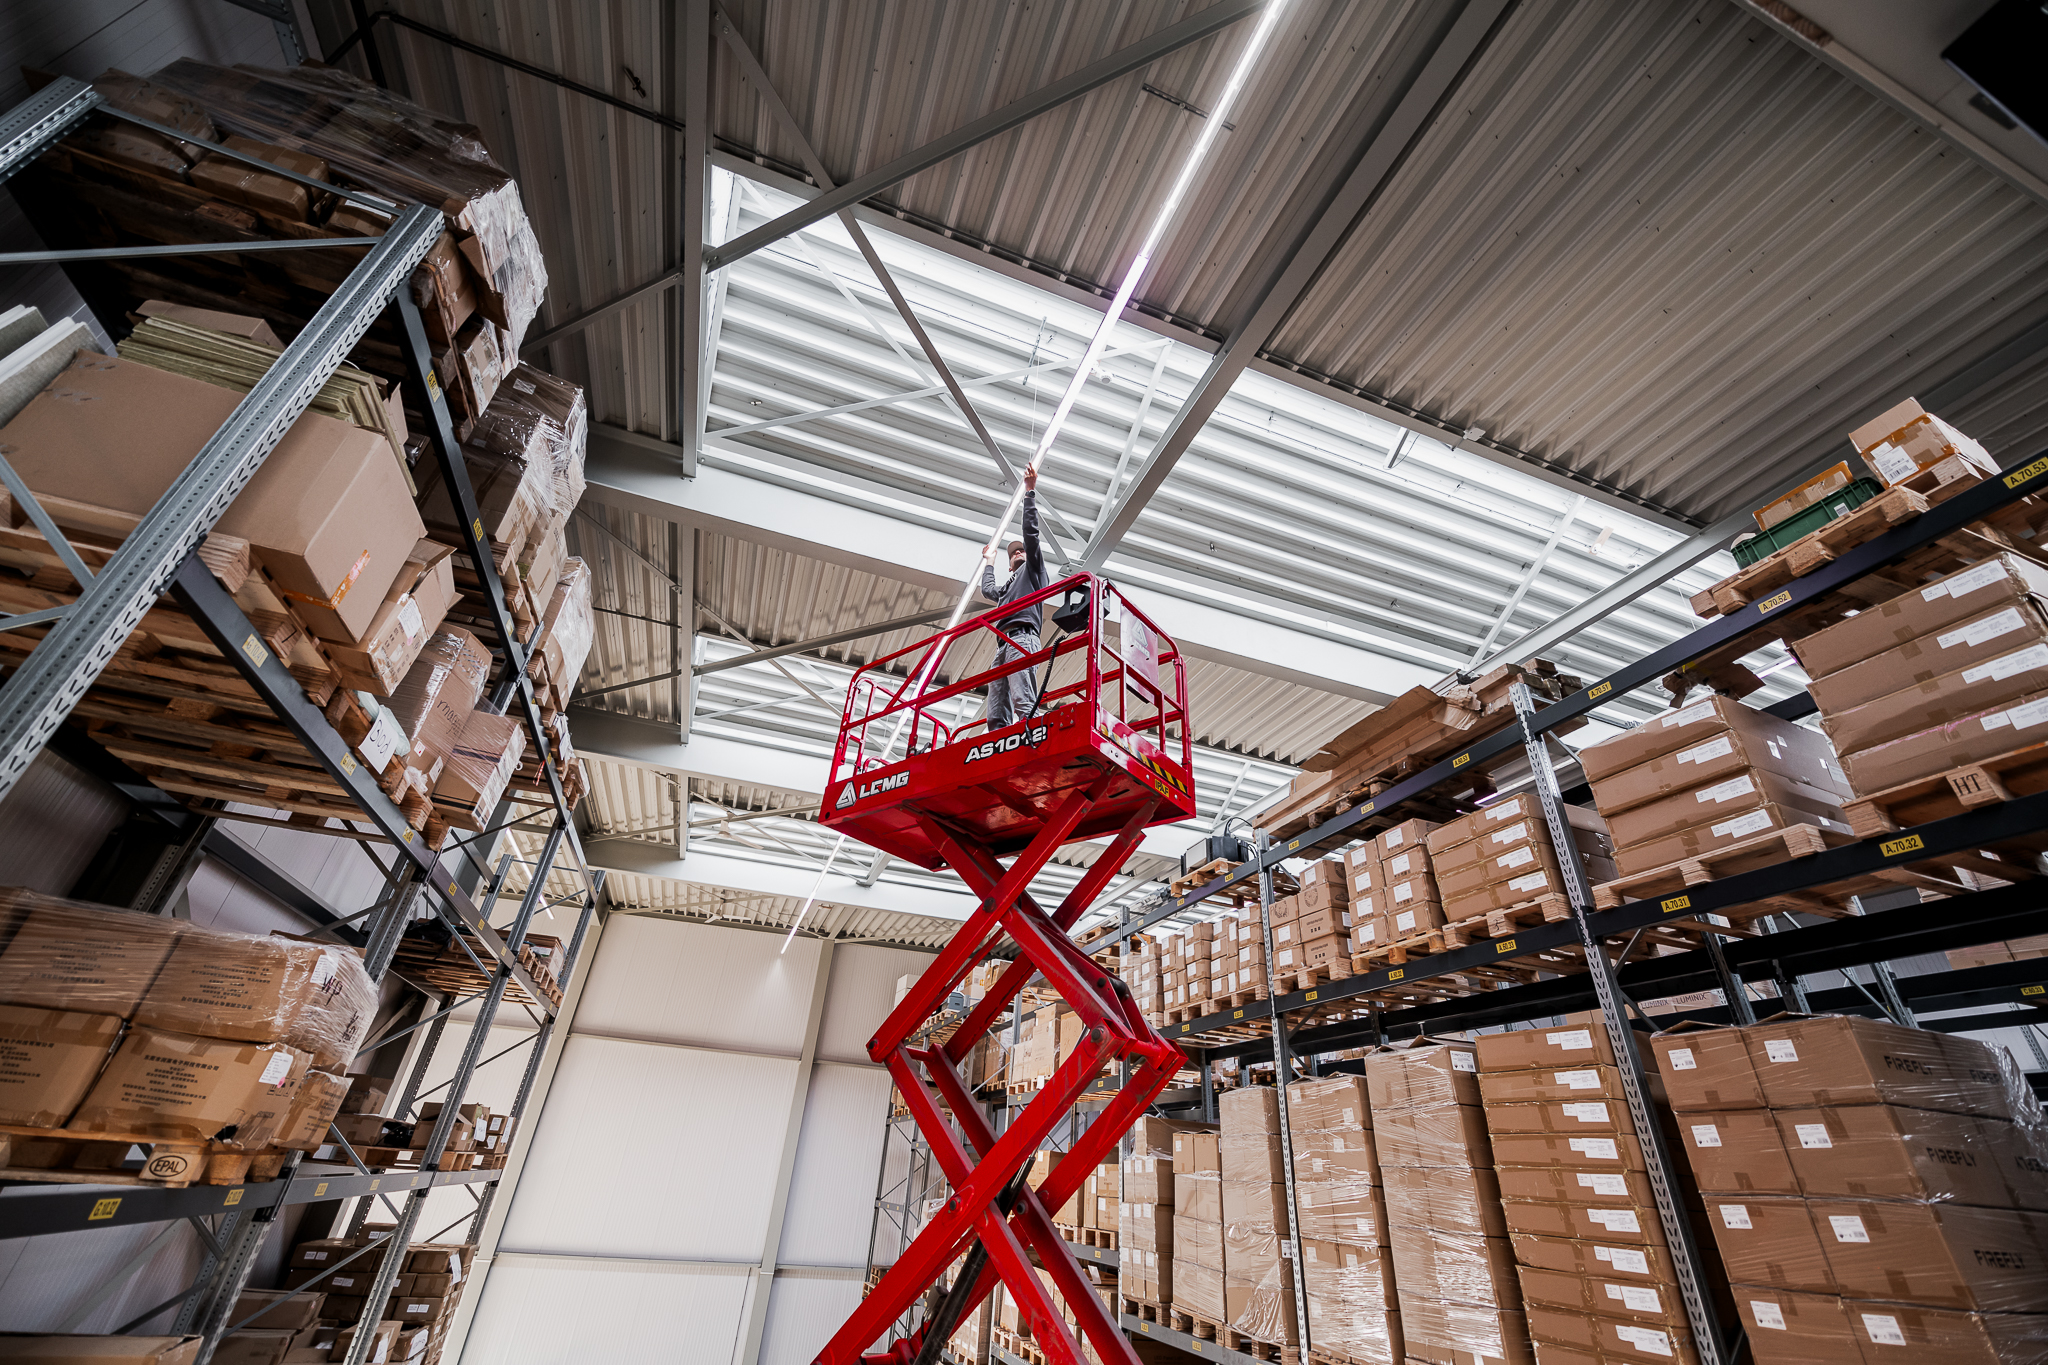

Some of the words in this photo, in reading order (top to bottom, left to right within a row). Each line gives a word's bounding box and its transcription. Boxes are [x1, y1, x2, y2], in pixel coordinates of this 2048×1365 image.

[2010, 461, 2047, 485] A.70.53
[1762, 593, 1788, 611] A.70.52
[1155, 781, 1169, 795] IPAF
[1952, 773, 1982, 797] HT
[1884, 837, 1919, 855] A.70.32
[1664, 897, 1687, 911] A.70.31
[1675, 992, 1707, 1005] LUMINIX
[1883, 1055, 1933, 1076] FIREFLY
[154, 1160, 180, 1173] EPAL
[1926, 1147, 1978, 1168] FIREFLY
[1974, 1249, 2026, 1269] FIREFLY
